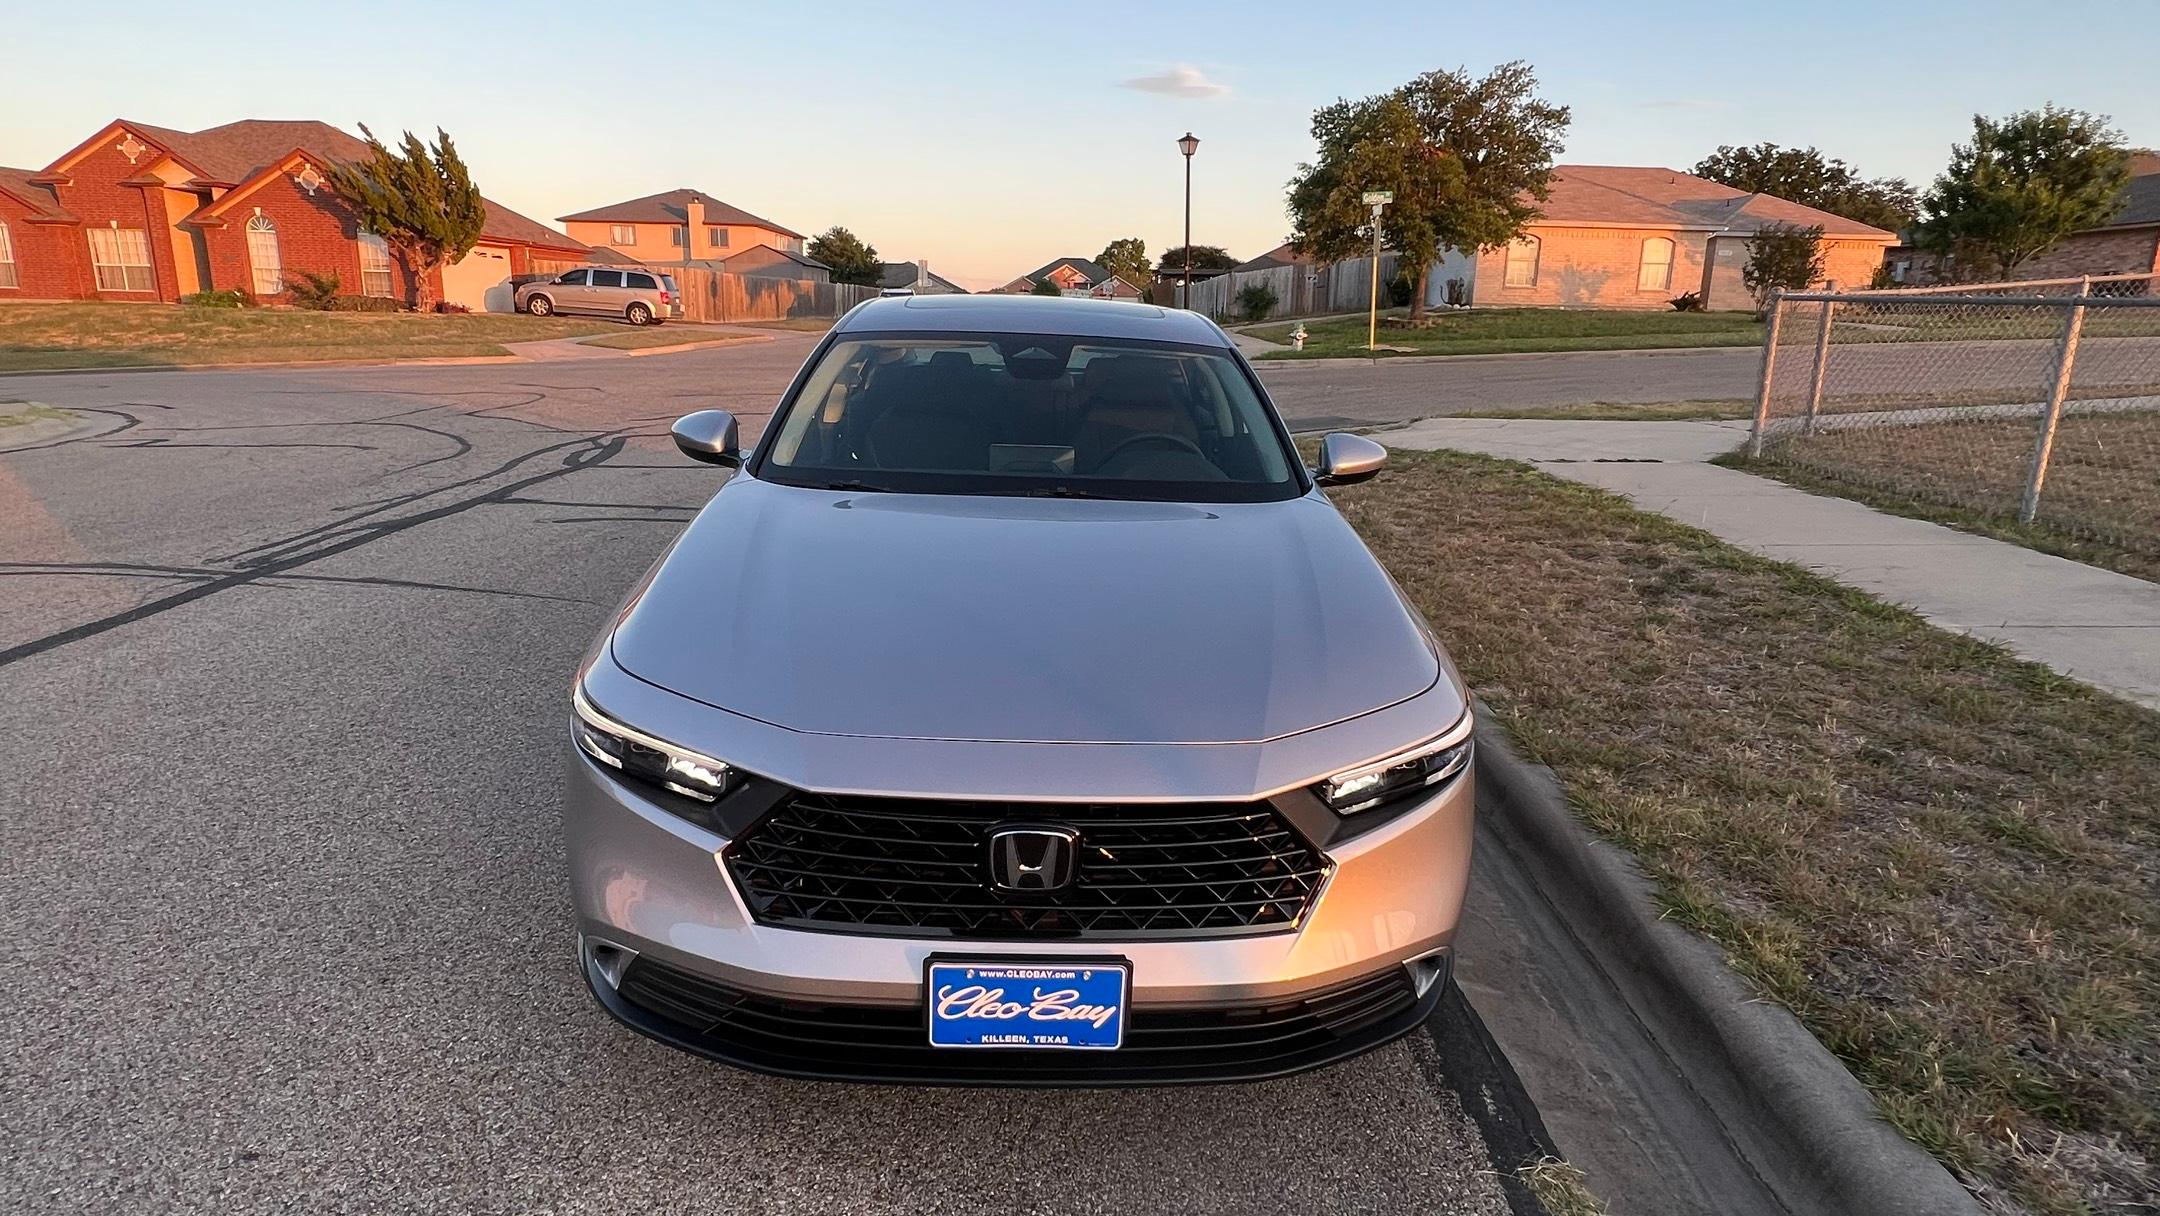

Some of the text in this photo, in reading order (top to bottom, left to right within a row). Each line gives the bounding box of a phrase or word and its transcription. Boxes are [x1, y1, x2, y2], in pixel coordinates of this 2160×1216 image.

[979, 970, 1076, 980] www.CLEOBAY.com
[937, 985, 1117, 1029] Cleo Bay
[982, 1035, 1069, 1045] KILLEEN, TEXAS
